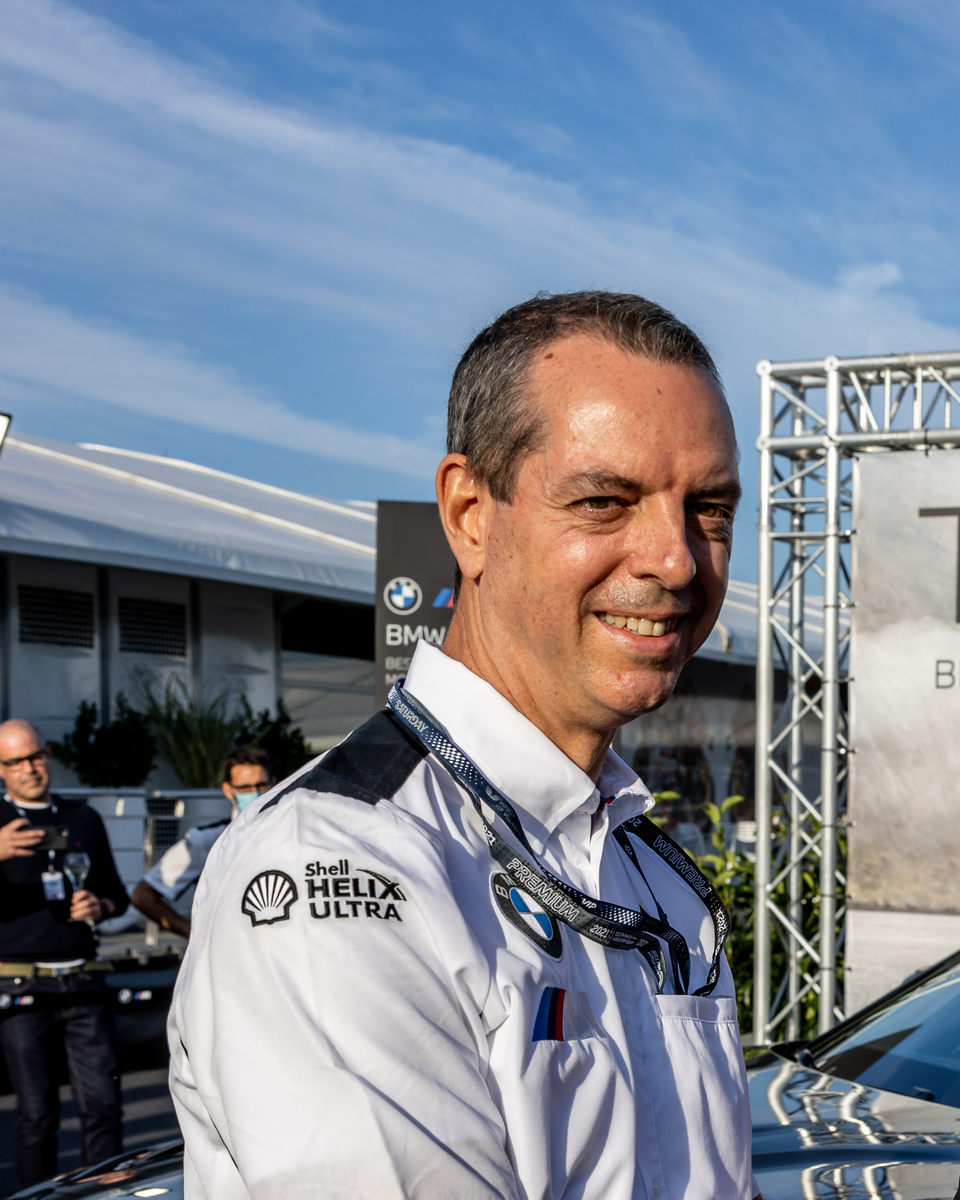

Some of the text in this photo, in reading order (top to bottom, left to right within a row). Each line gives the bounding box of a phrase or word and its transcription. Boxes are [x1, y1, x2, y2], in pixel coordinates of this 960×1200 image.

[385, 623, 446, 648] BMW
[394, 699, 428, 732] SATURDAY
[305, 859, 350, 877] Shell
[653, 834, 712, 898] PREMIUM
[305, 875, 407, 901] HELIX
[506, 857, 580, 922] PREMIUM
[309, 900, 403, 922] ULTRA
[589, 923, 611, 939] 2021
